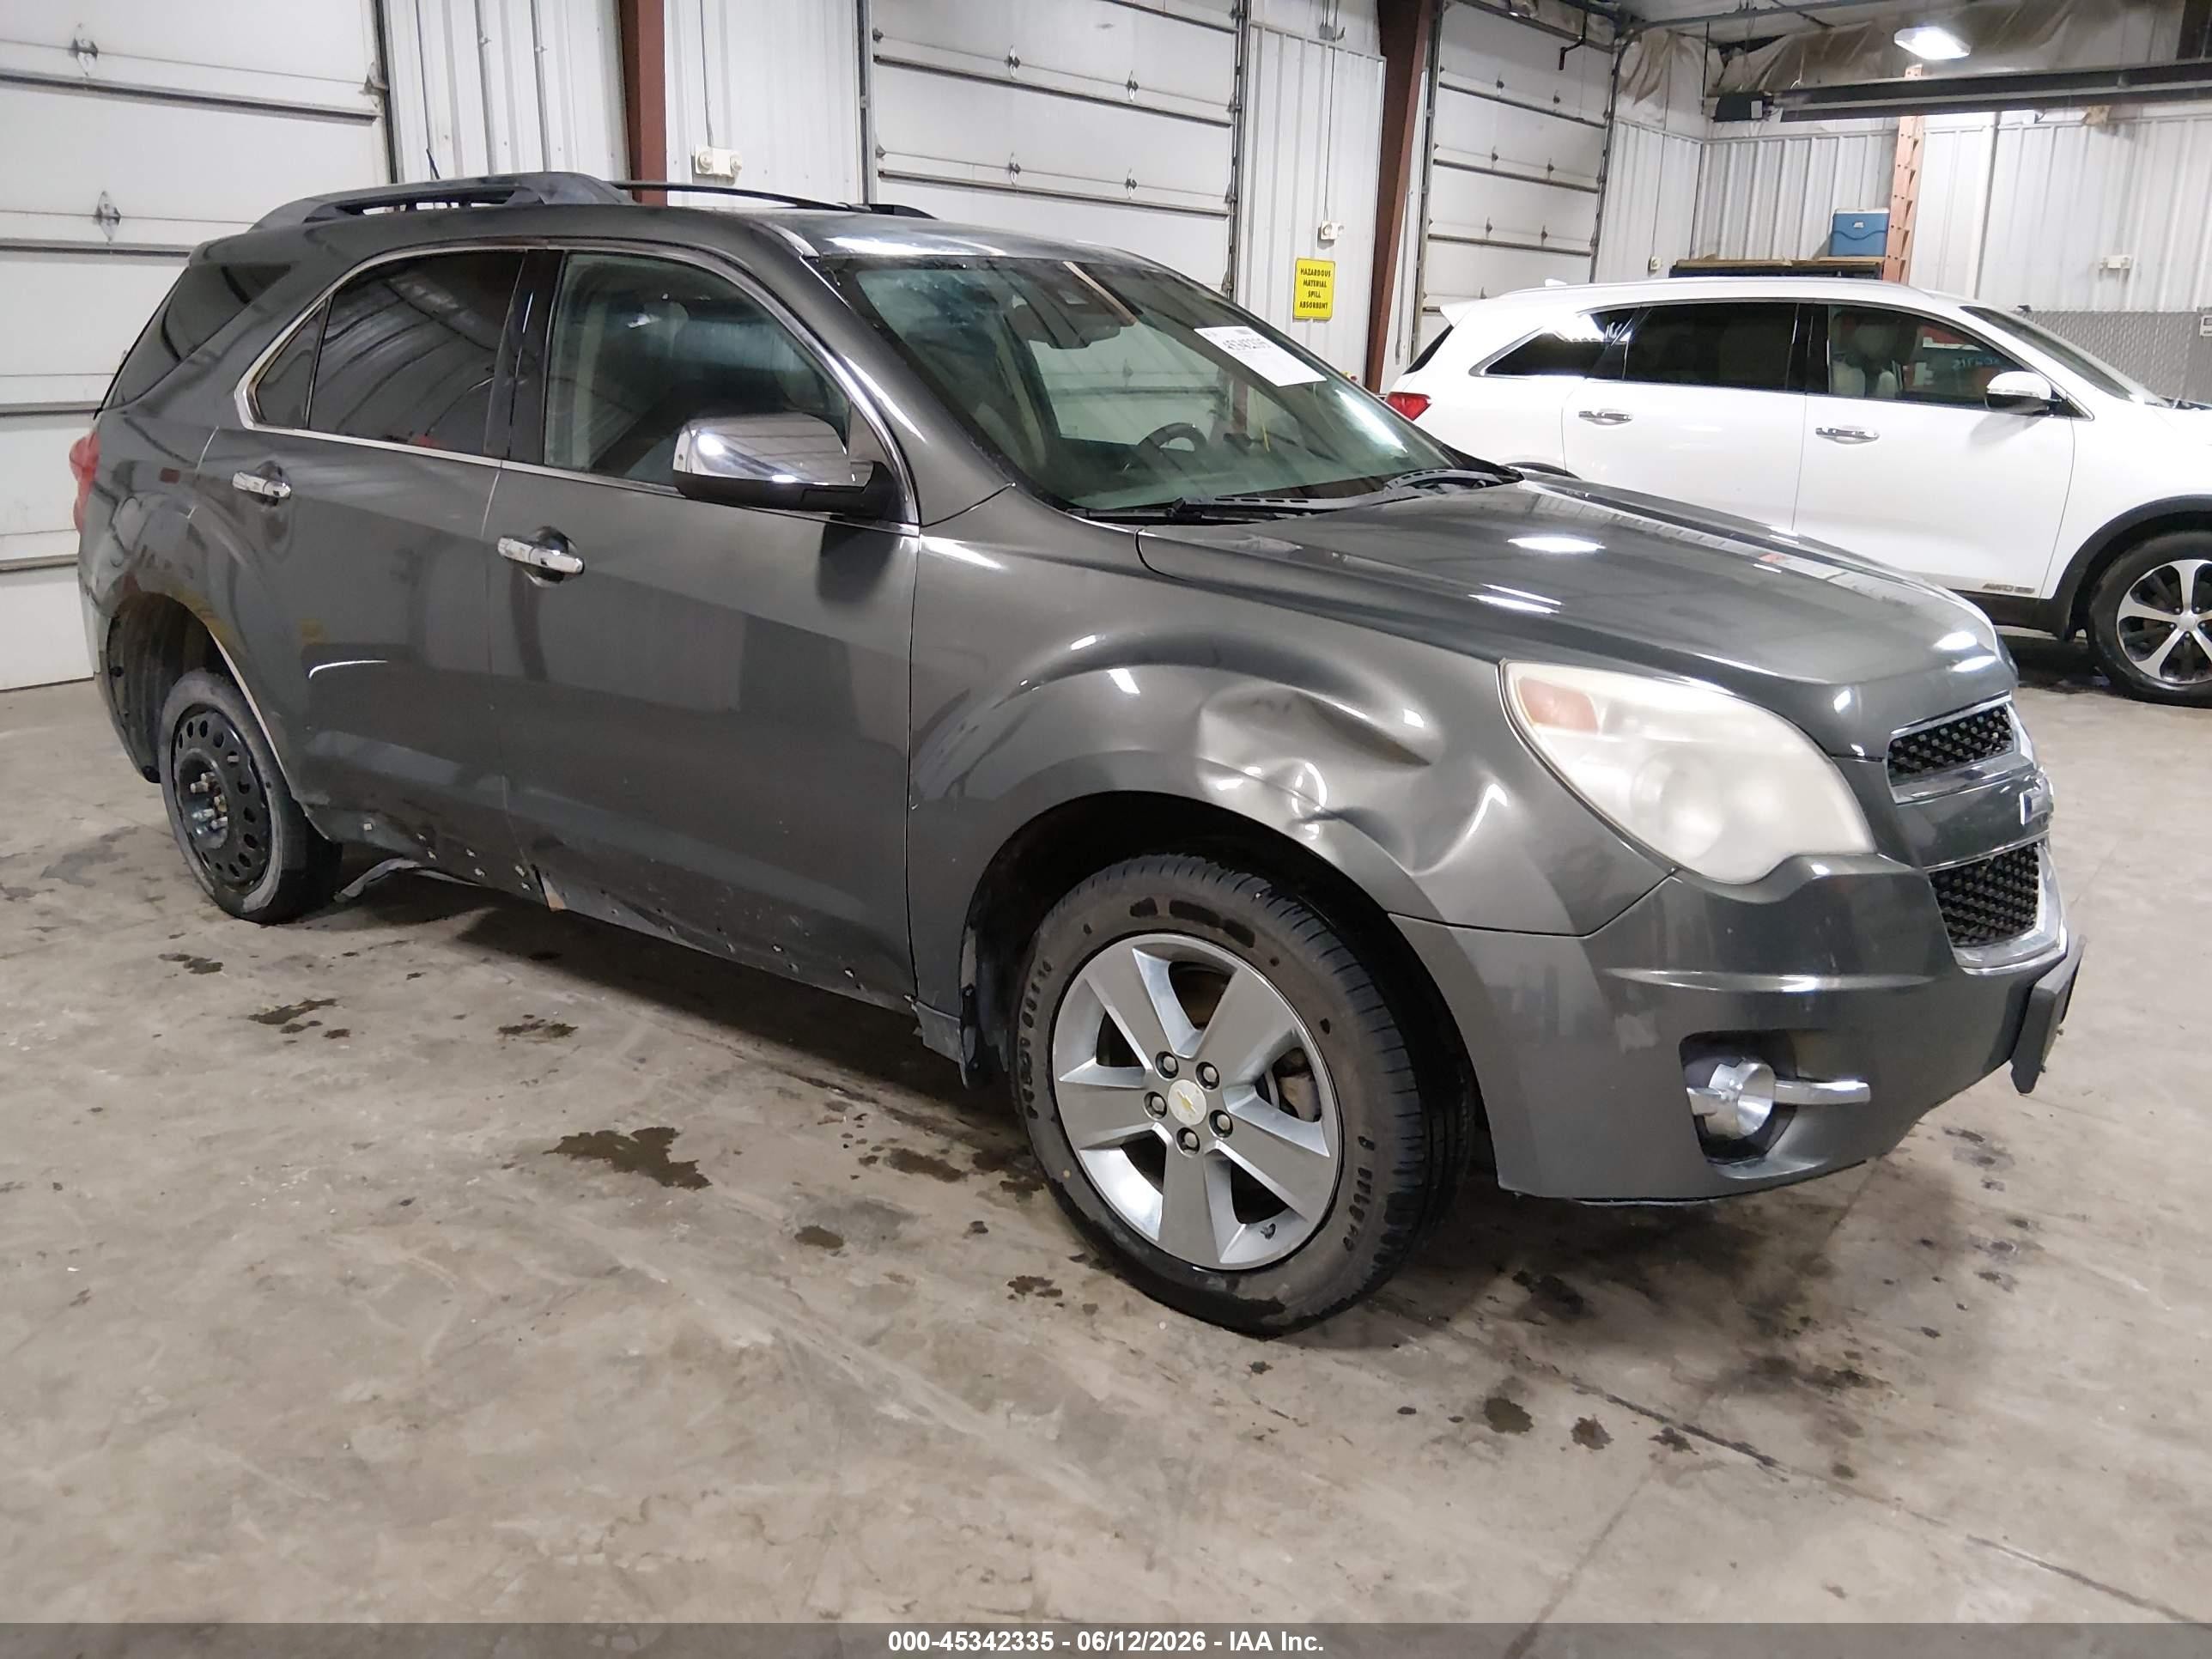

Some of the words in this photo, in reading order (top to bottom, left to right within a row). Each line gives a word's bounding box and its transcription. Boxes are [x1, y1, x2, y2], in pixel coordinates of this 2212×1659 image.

[1300, 268, 1331, 277] HAZARDOUS
[1303, 279, 1327, 288] MATERIAL
[1299, 301, 1328, 309] ABSORBENT
